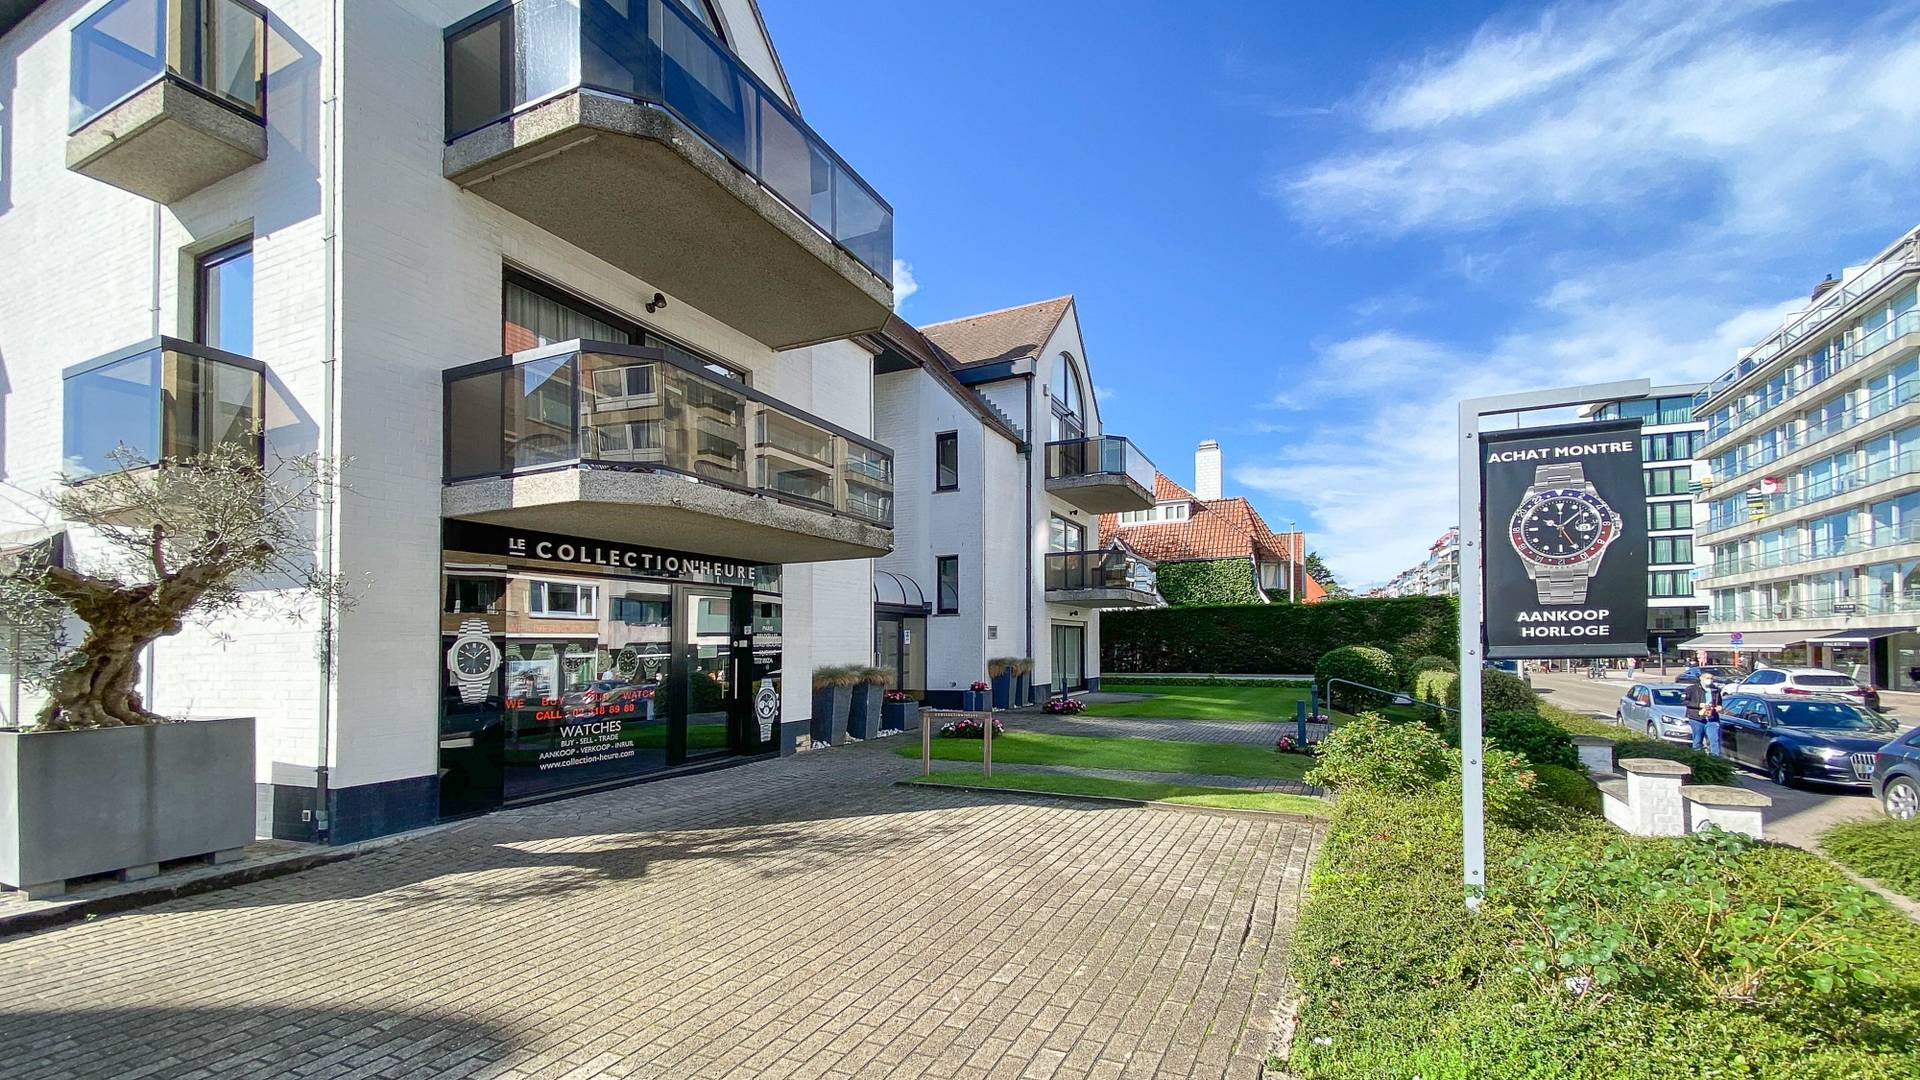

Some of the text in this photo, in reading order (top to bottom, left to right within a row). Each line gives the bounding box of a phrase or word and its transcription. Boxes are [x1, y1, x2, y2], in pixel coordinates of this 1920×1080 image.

[1487, 441, 1633, 464] ACHAT MONTRE
[509, 537, 526, 550] LE
[1517, 610, 1610, 623] AANKOOP
[1521, 625, 1610, 638] HORLOGE
[505, 698, 526, 710] WE
[536, 710, 562, 720] CALL
[560, 720, 622, 738] WATCHES
[561, 740, 574, 748] BUY
[580, 737, 593, 745] SELL
[599, 733, 619, 742] TRADE
[539, 748, 575, 760] AANKOOP
[580, 743, 610, 754] VERKOOP
[615, 740, 634, 749] INRUIL
[540, 750, 635, 771] www.collection-heure.com
